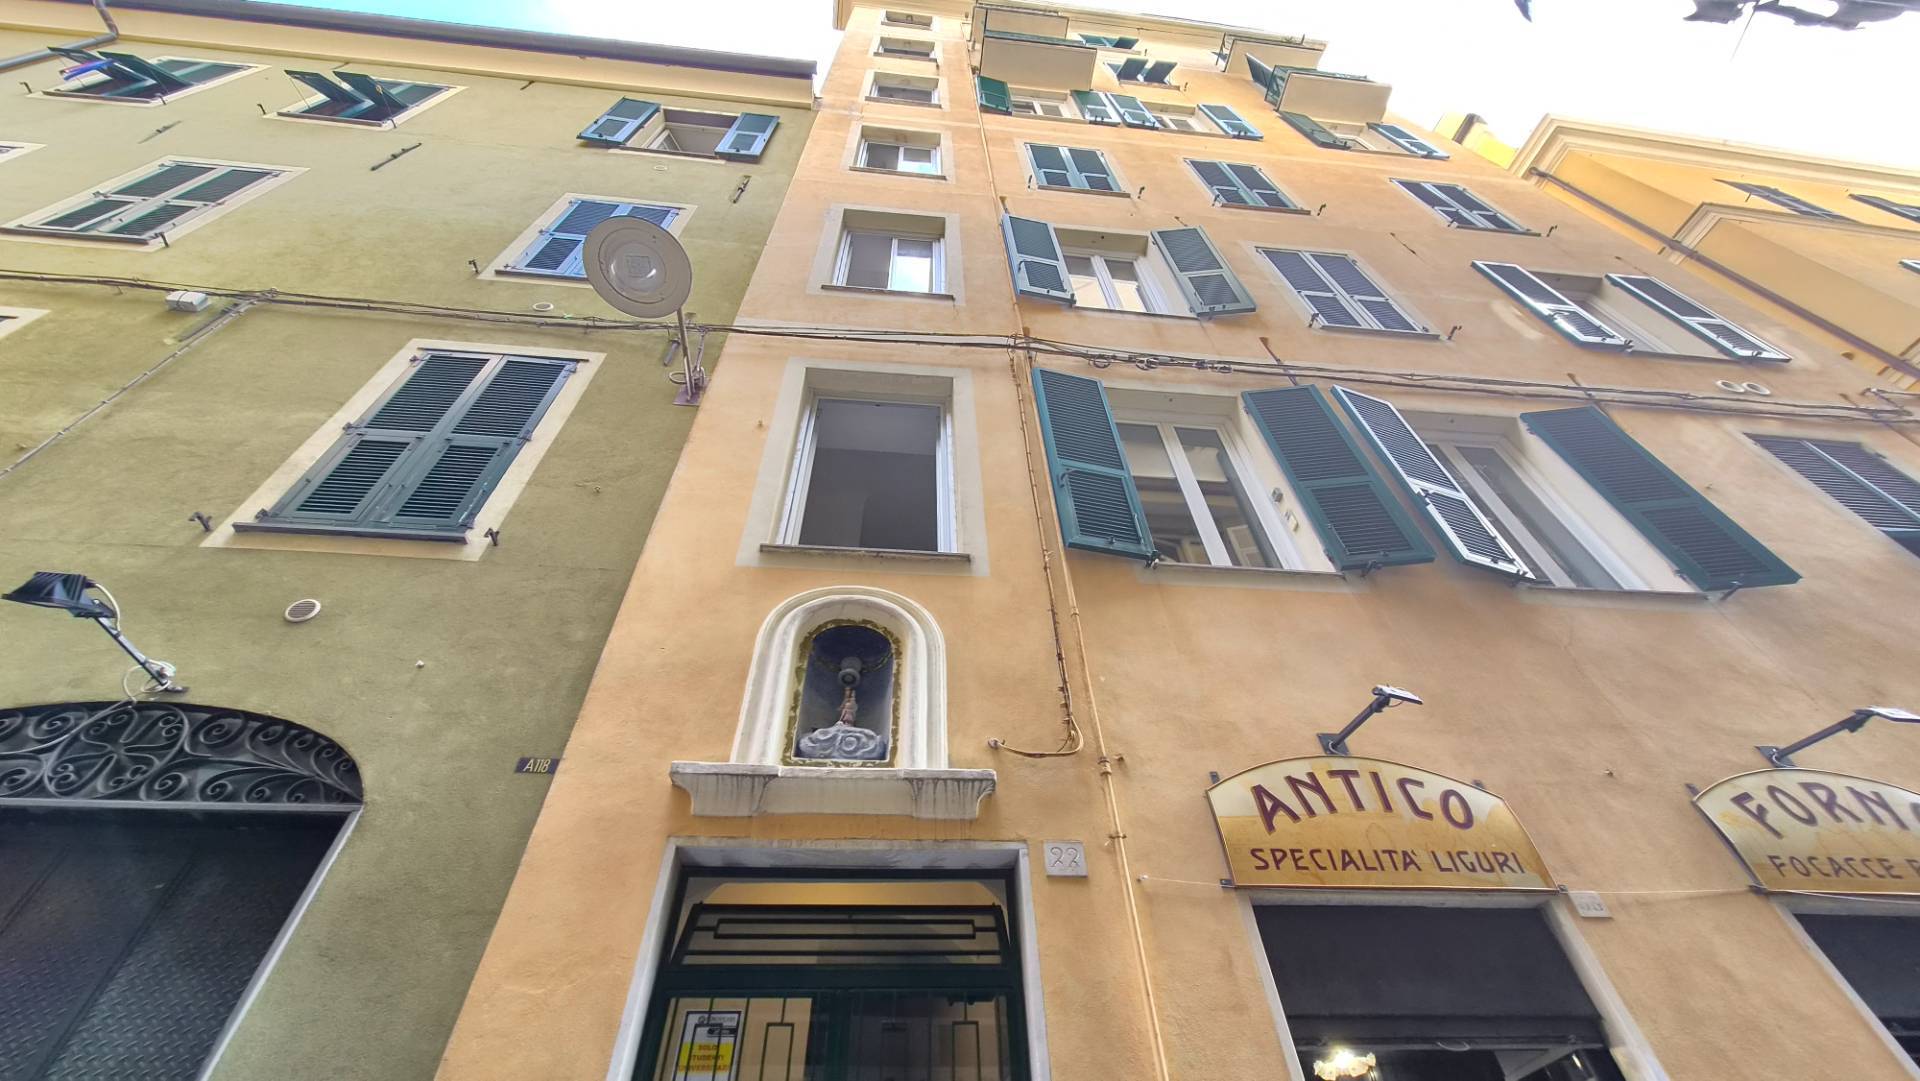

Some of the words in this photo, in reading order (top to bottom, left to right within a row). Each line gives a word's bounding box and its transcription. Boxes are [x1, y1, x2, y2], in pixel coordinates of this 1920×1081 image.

[522, 758, 551, 773] A118
[1250, 769, 1475, 835] ANTICO
[1050, 846, 1081, 868] 22
[1430, 850, 1526, 874] LIGURI
[1766, 855, 1904, 879] FOCACCE
